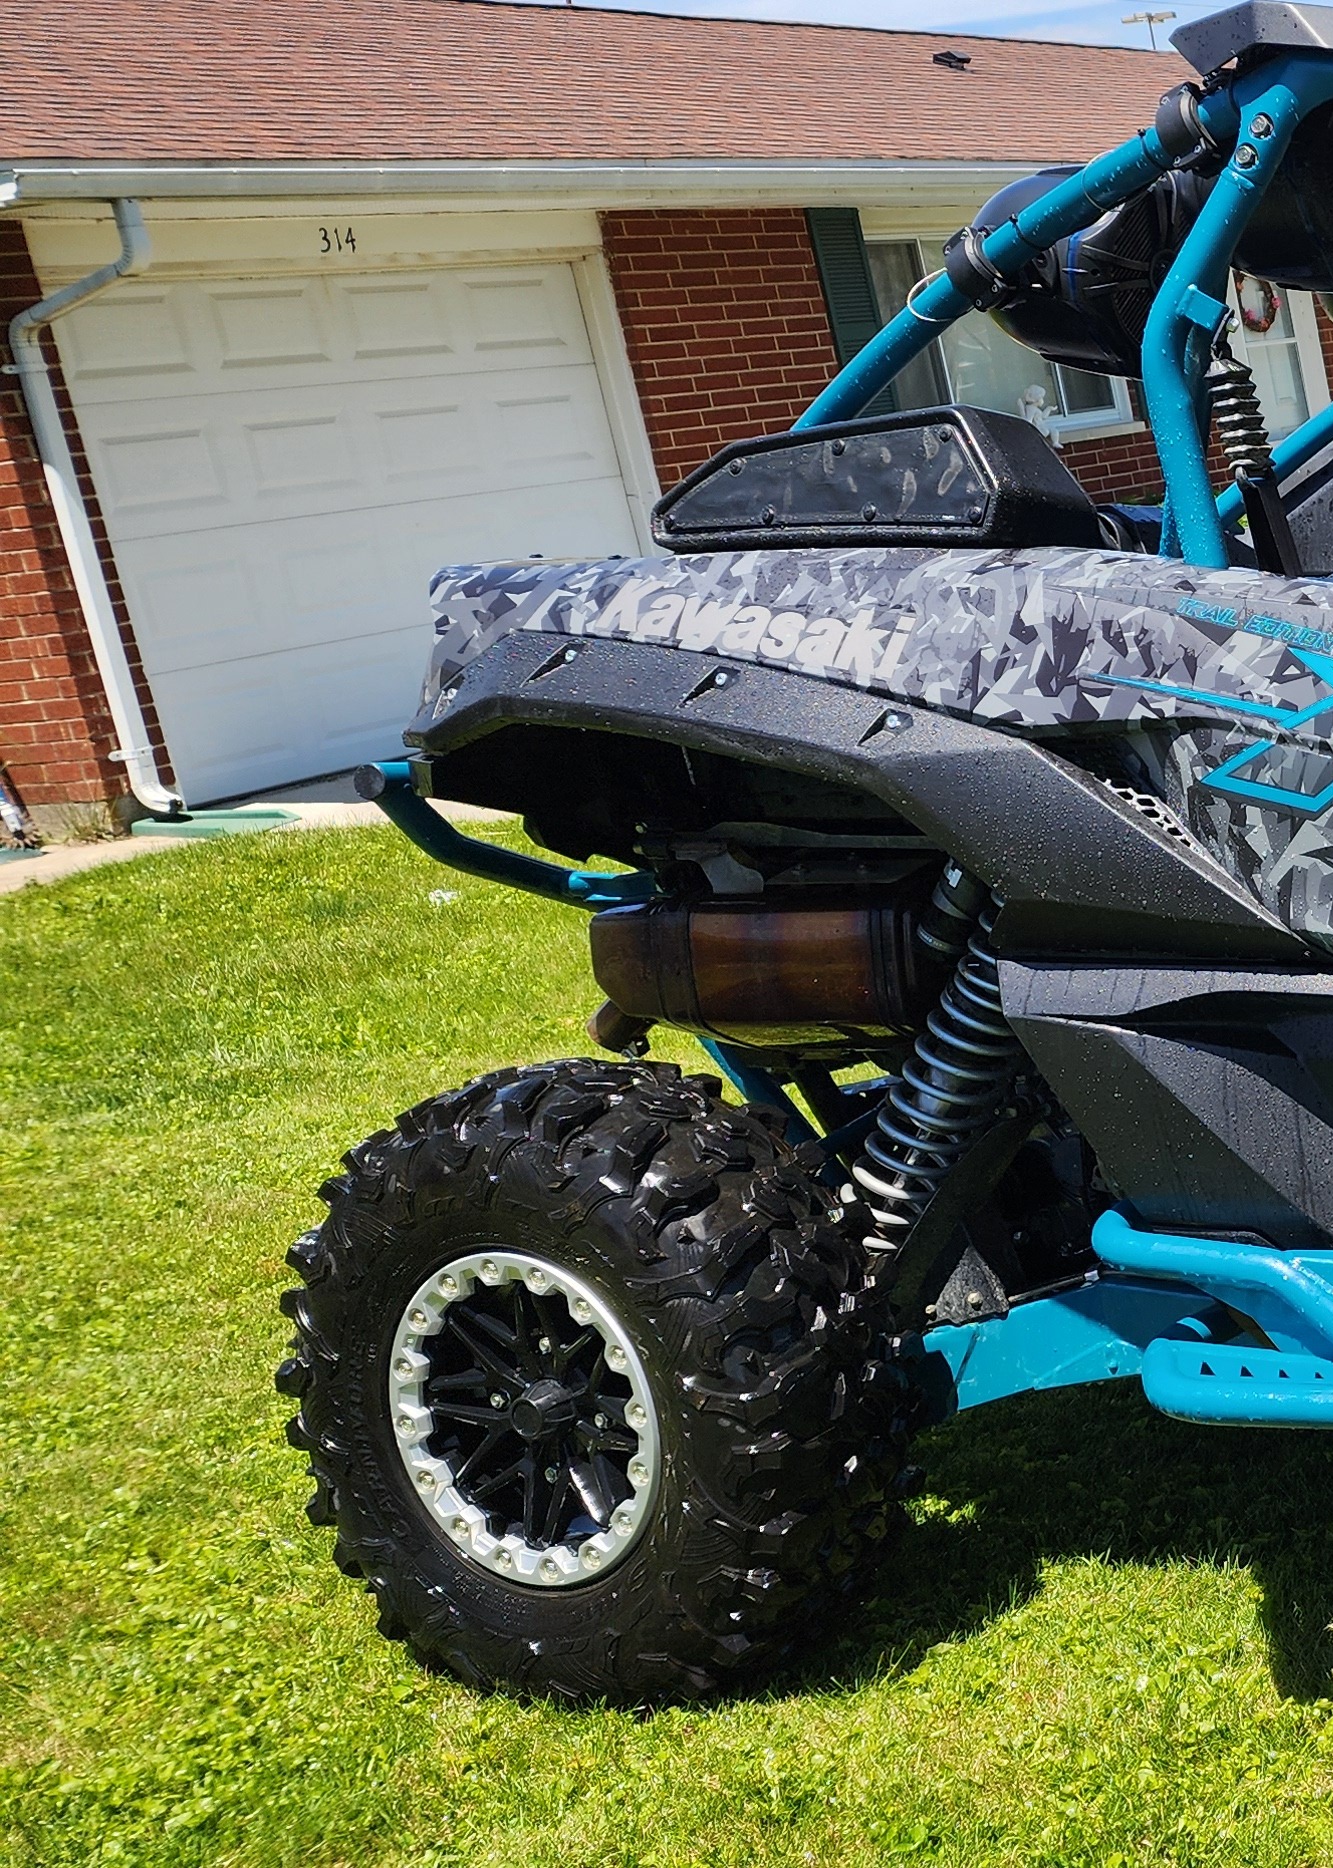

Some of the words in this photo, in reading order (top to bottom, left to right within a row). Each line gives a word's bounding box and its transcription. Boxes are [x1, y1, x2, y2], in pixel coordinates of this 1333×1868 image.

[318, 227, 356, 253] 314
[1176, 597, 1239, 627] TRAIL
[594, 578, 917, 680] Kawasaki
